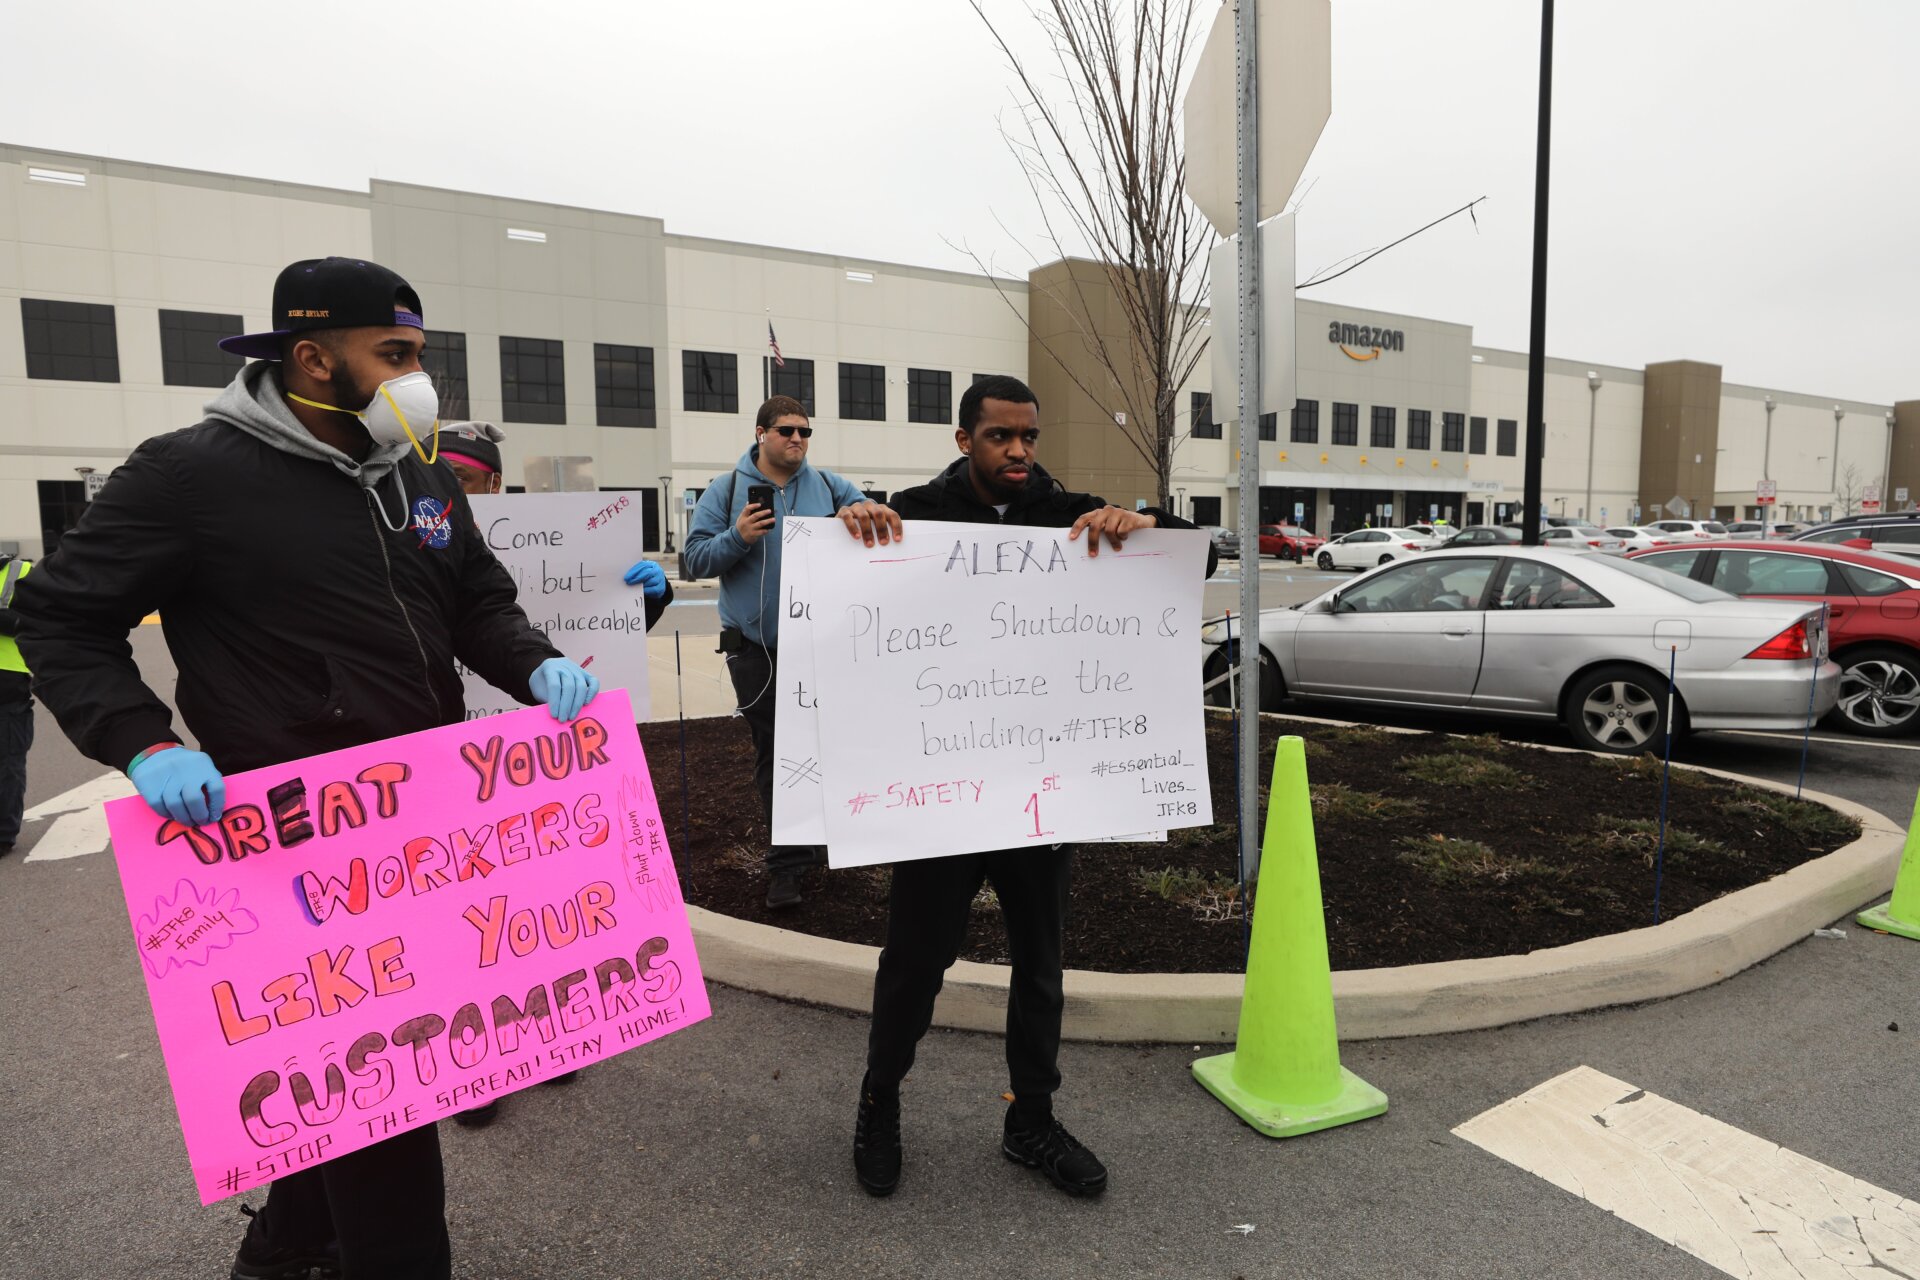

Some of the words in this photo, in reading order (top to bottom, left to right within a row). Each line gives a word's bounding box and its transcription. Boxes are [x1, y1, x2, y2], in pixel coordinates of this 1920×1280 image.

[1329, 321, 1404, 352] amazon
[414, 514, 451, 530] NASA
[587, 495, 630, 531] #JFK8
[487, 517, 564, 550] Come
[542, 560, 597, 594] but
[944, 539, 1068, 577] ALEXA
[846, 603, 958, 662] Please
[990, 601, 1141, 640] Shutdown
[1157, 606, 1179, 638] &
[916, 666, 1048, 707] Sanitize
[1075, 660, 1134, 693] the
[155, 762, 411, 865] TREAT
[460, 716, 611, 802] YOUR
[1157, 801, 1198, 817] JFK8
[293, 793, 611, 926] WORKERS
[461, 840, 482, 865] JFK8
[308, 891, 325, 917] JFK8
[145, 907, 195, 951] #JFK8
[210, 937, 415, 1046] LIKE
[462, 881, 617, 968] YOUR
[238, 937, 682, 1148] CUSTOMERS
[217, 1133, 334, 1192] #STOP
[358, 1103, 419, 1139] THE
[435, 1057, 543, 1112] SPREAD!
[549, 1035, 604, 1071] STAY
[617, 997, 688, 1044] HOME!
